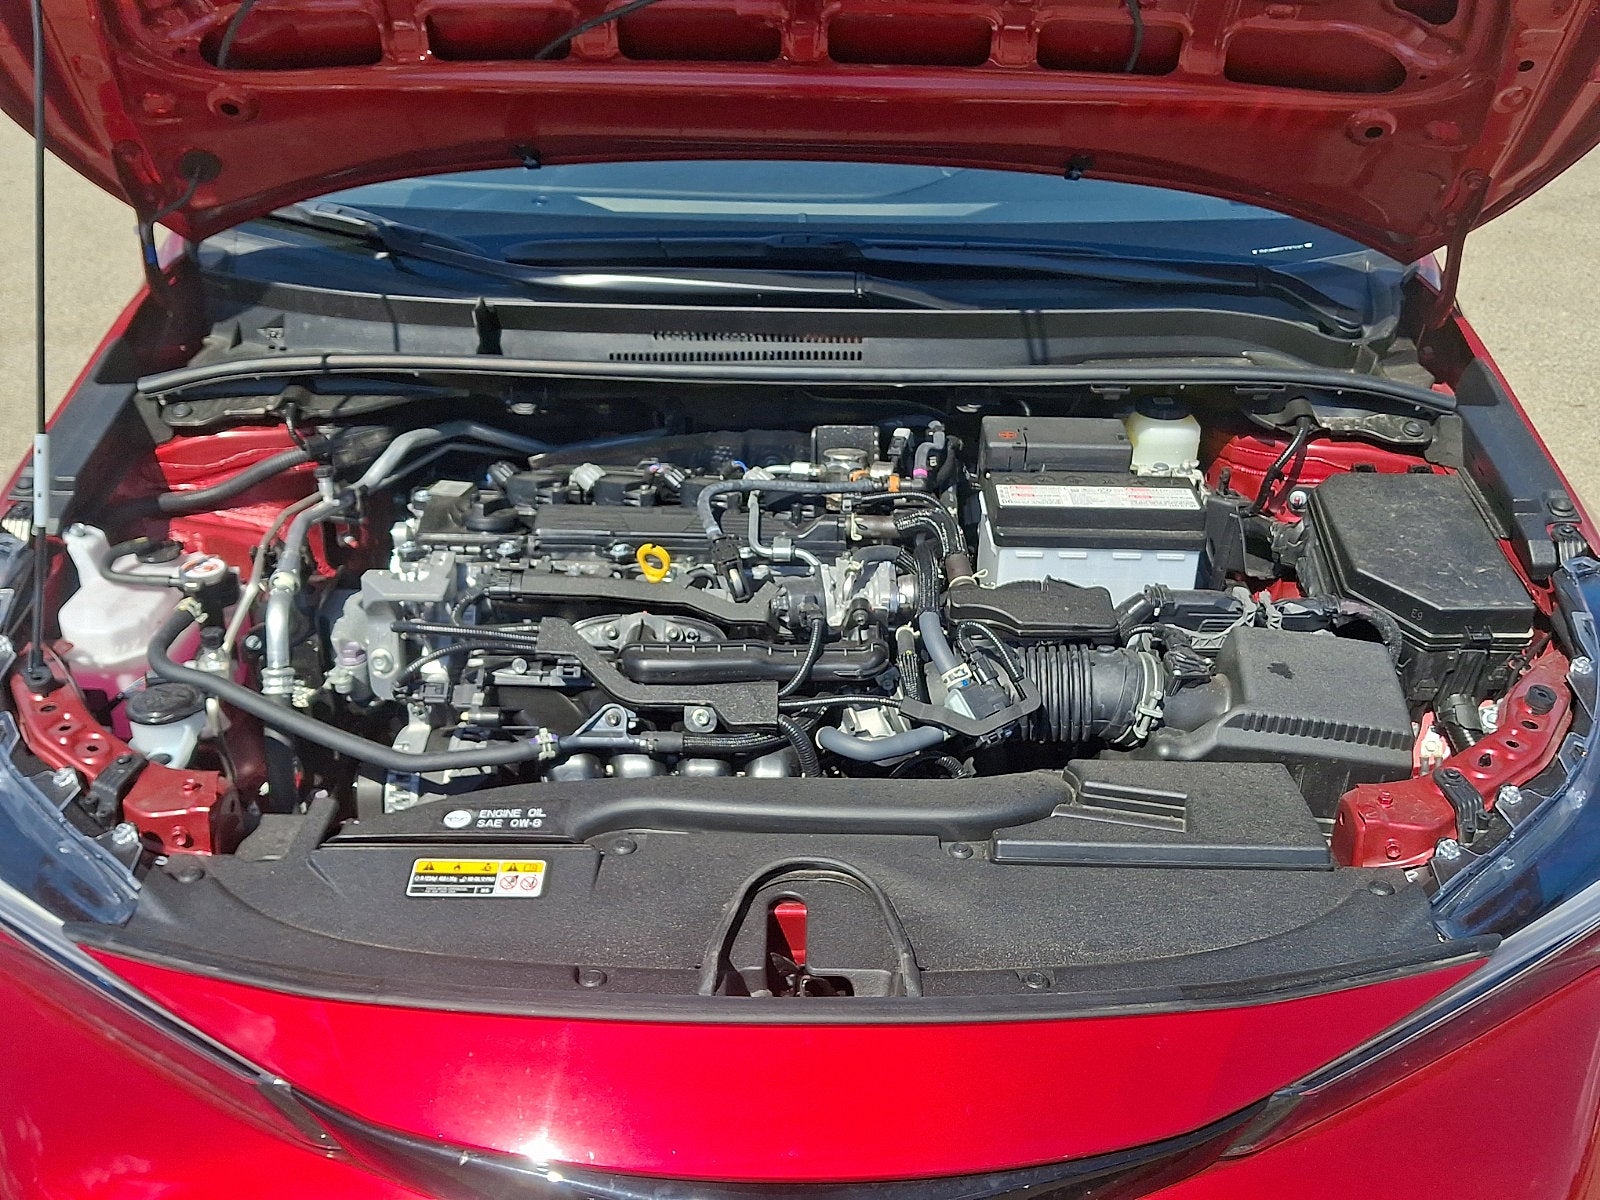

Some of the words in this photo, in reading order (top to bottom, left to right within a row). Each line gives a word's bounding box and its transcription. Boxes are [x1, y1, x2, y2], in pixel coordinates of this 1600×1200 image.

[477, 808, 522, 819] ENGINE
[527, 807, 547, 818] OIL
[476, 818, 504, 828] SAE
